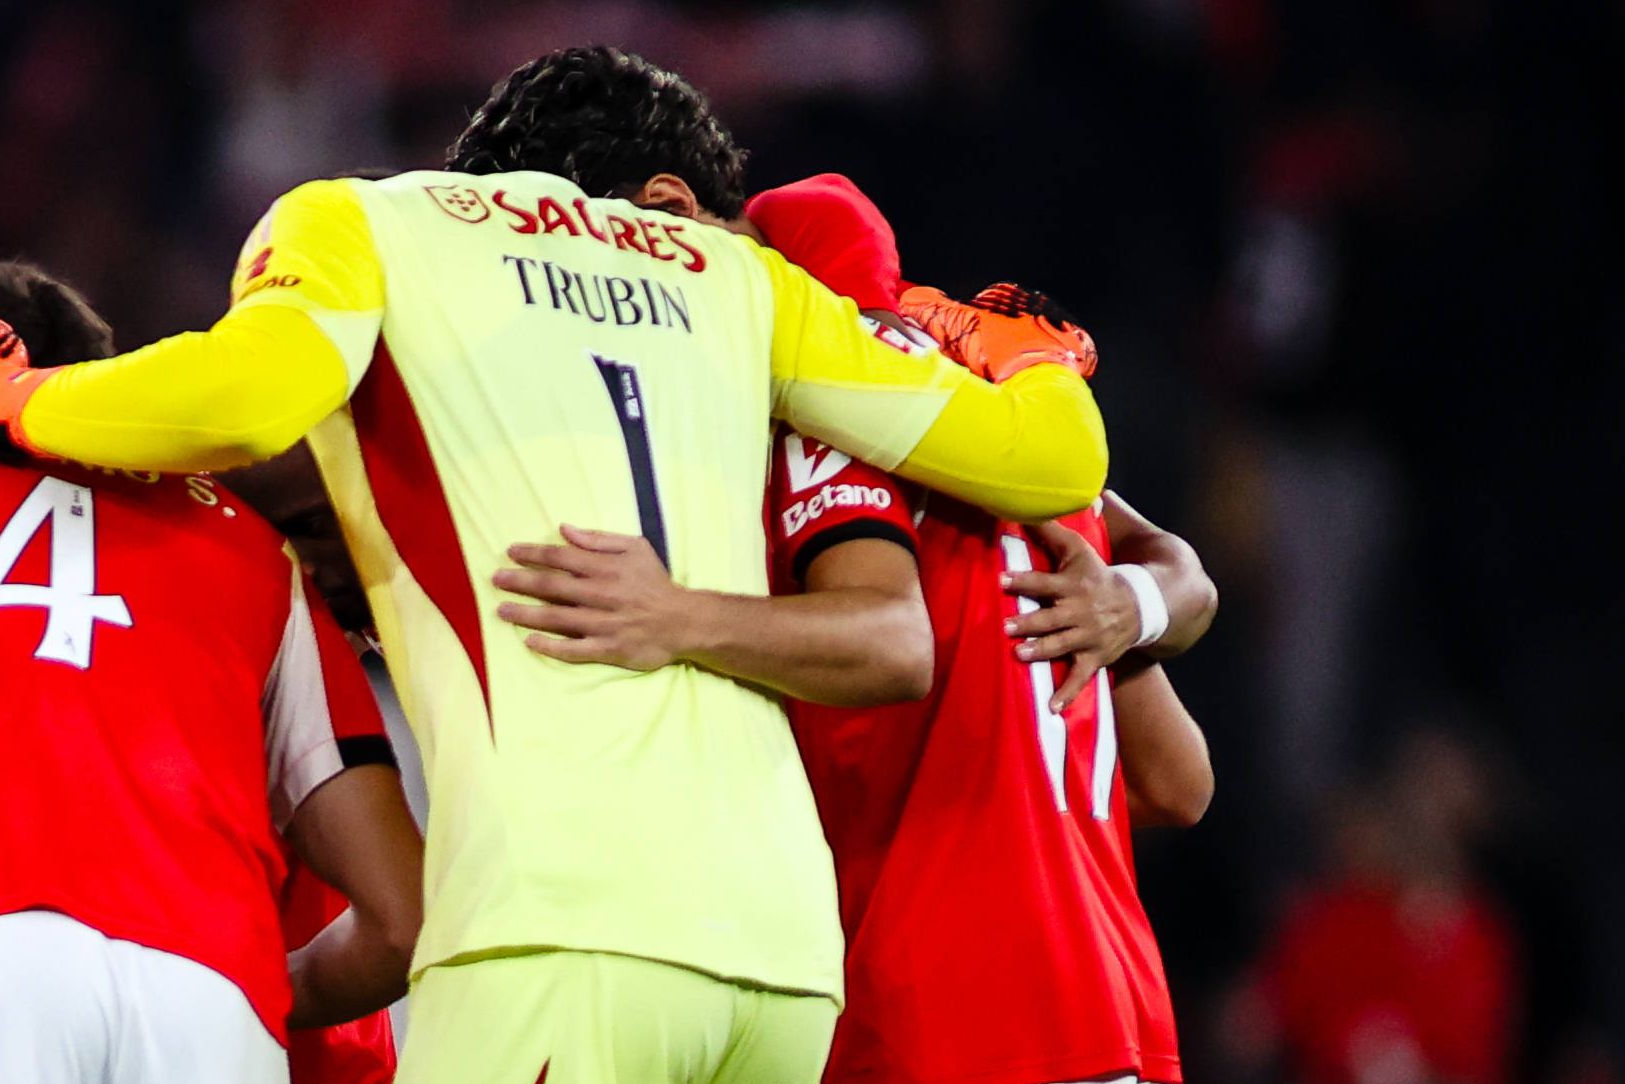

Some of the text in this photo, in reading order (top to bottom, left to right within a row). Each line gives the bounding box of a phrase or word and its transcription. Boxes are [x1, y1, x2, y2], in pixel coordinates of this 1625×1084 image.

[503, 255, 692, 333] TRUBIN
[590, 354, 672, 576] 1
[782, 484, 892, 538] Betano
